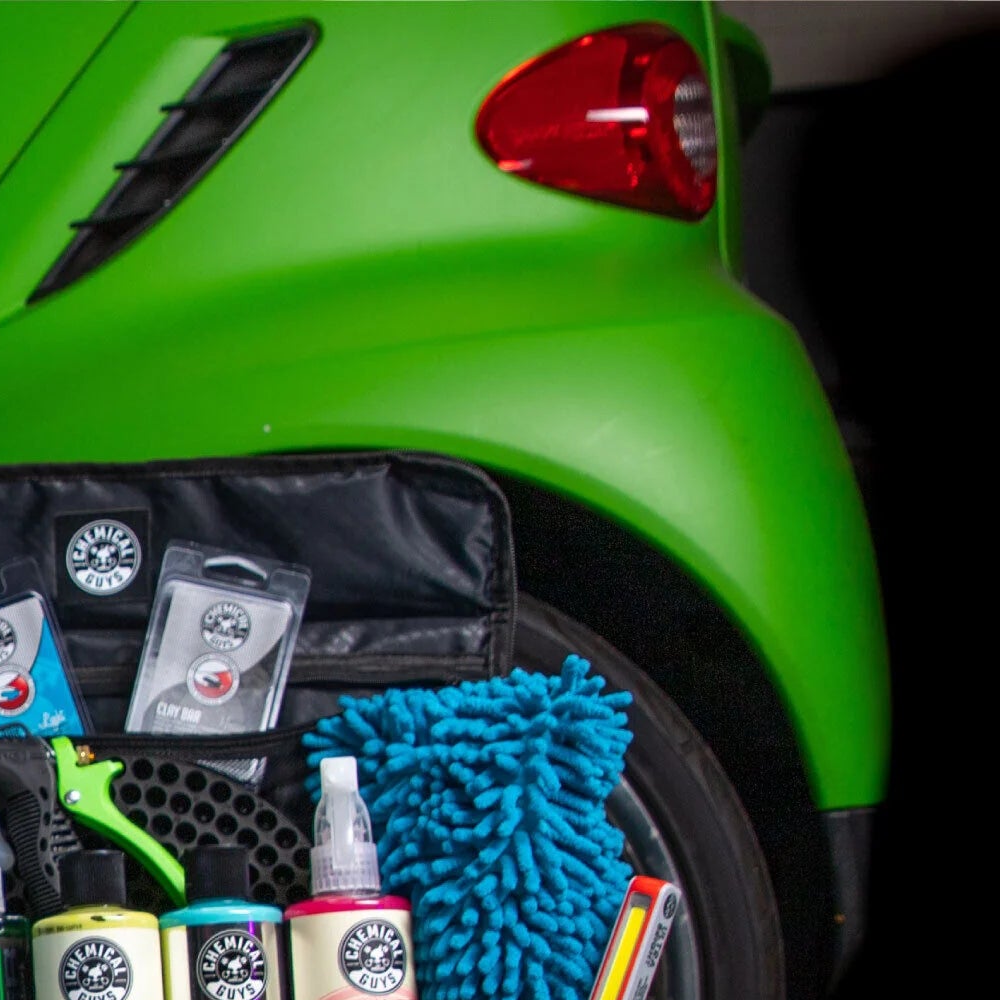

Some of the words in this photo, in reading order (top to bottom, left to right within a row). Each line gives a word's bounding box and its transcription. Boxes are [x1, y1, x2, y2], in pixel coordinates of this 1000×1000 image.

[72, 525, 135, 561] CHEMICAL
[85, 571, 123, 588] GUYS
[156, 701, 179, 718] CLAY
[203, 935, 263, 972] CHEMICAL
[345, 924, 403, 960] CHEMICAL
[65, 943, 127, 979] CHEMICAL
[216, 983, 256, 1000] GUYS
[359, 973, 397, 988] GUYS
